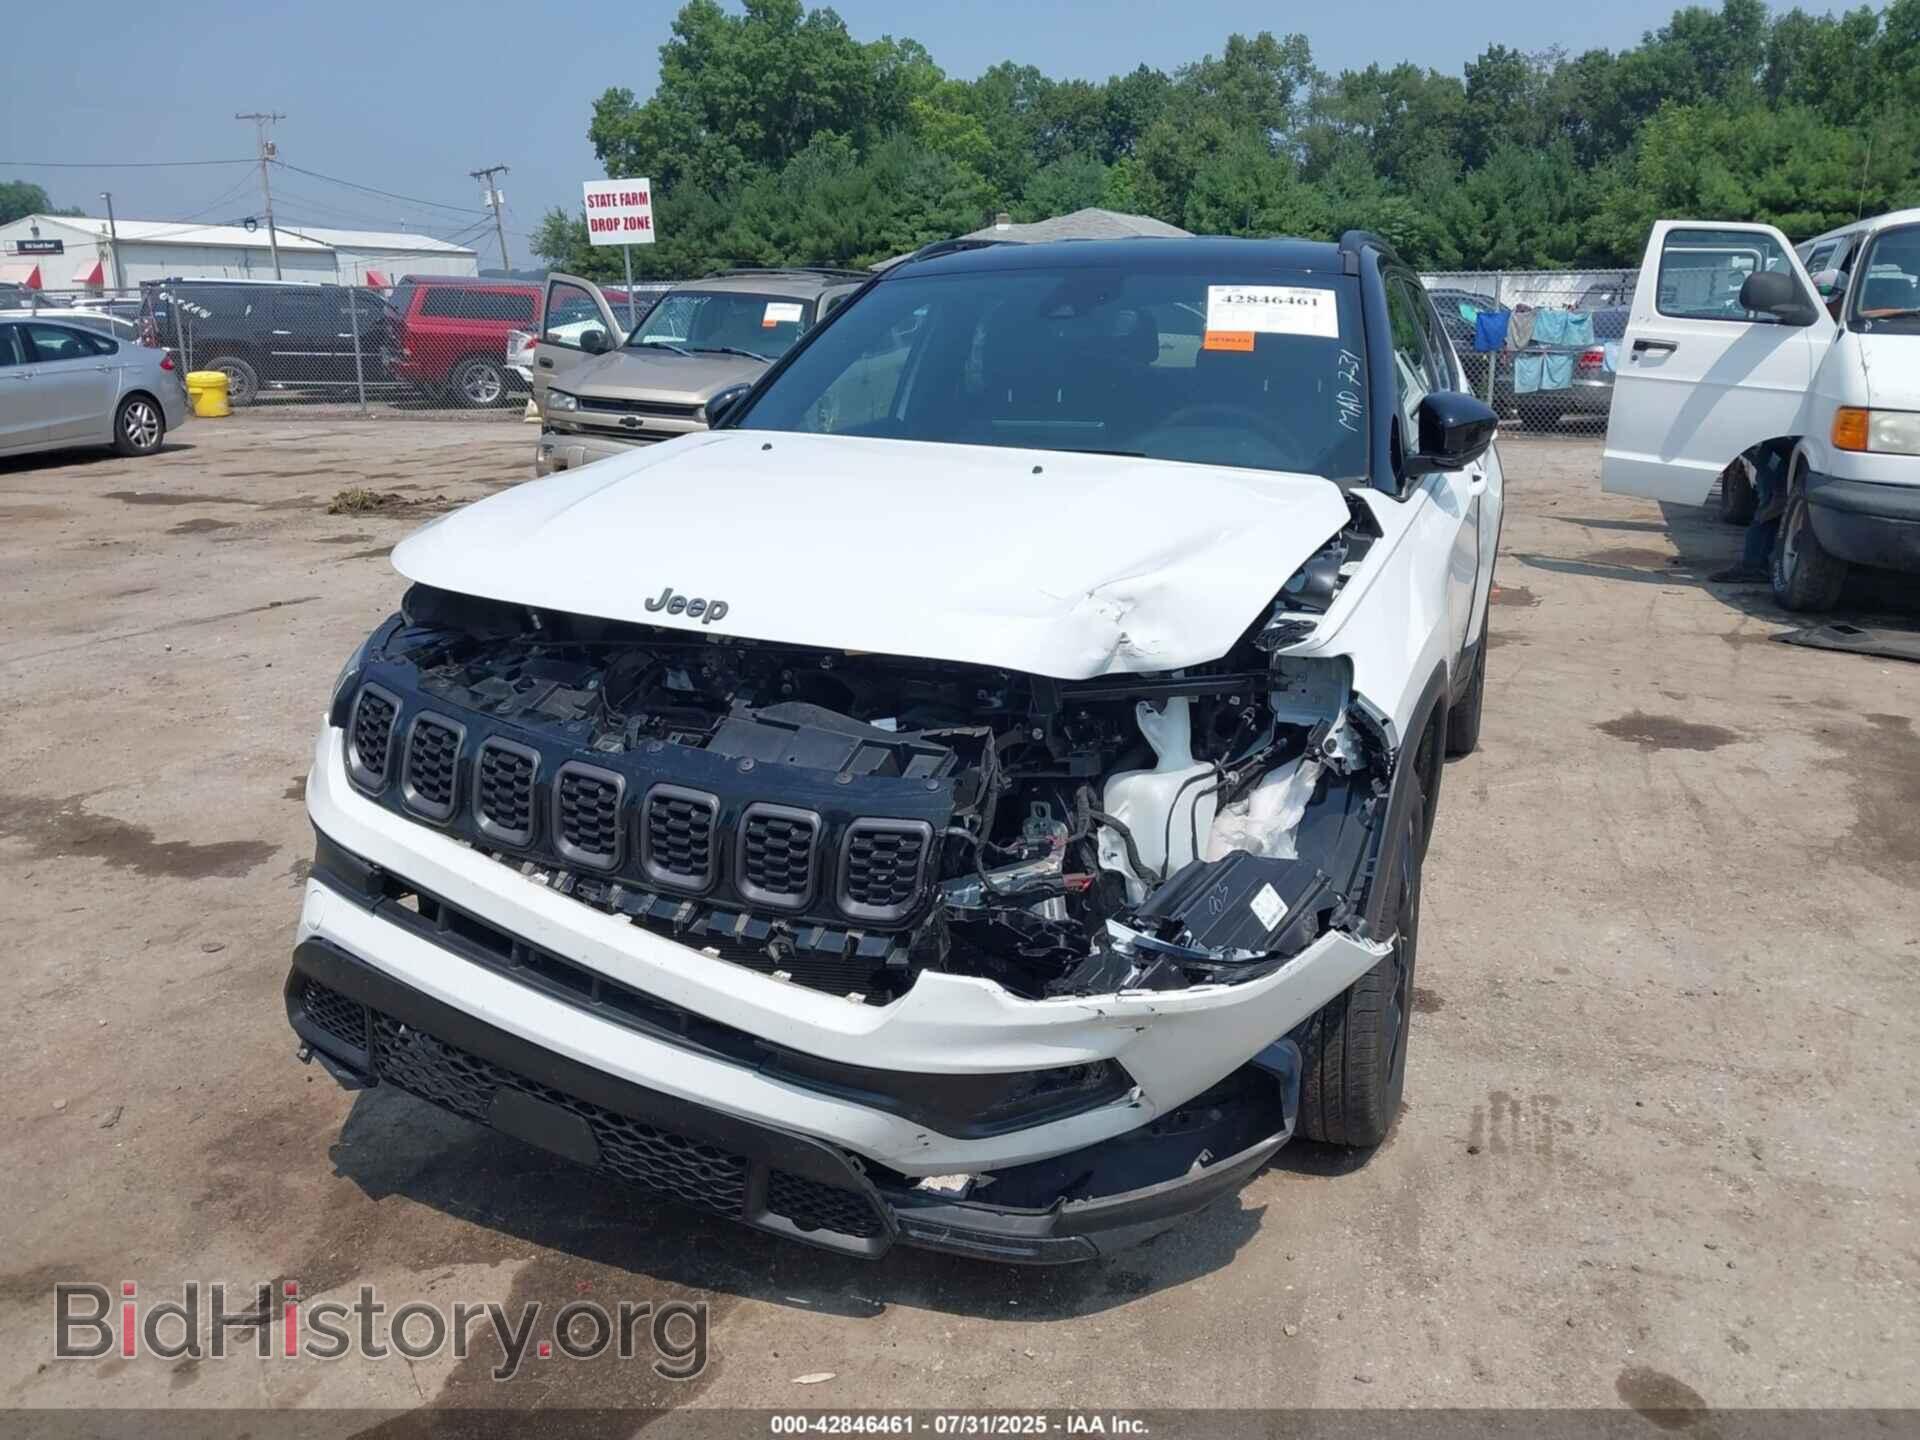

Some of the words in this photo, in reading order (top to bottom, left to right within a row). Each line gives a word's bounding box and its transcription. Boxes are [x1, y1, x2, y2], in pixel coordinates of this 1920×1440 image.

[587, 193, 617, 208] STATE
[620, 191, 648, 206] FARM
[590, 217, 620, 232] DROP
[623, 215, 650, 230] ZONE
[1221, 295, 1318, 306] 42846461
[644, 587, 729, 625] Jeep
